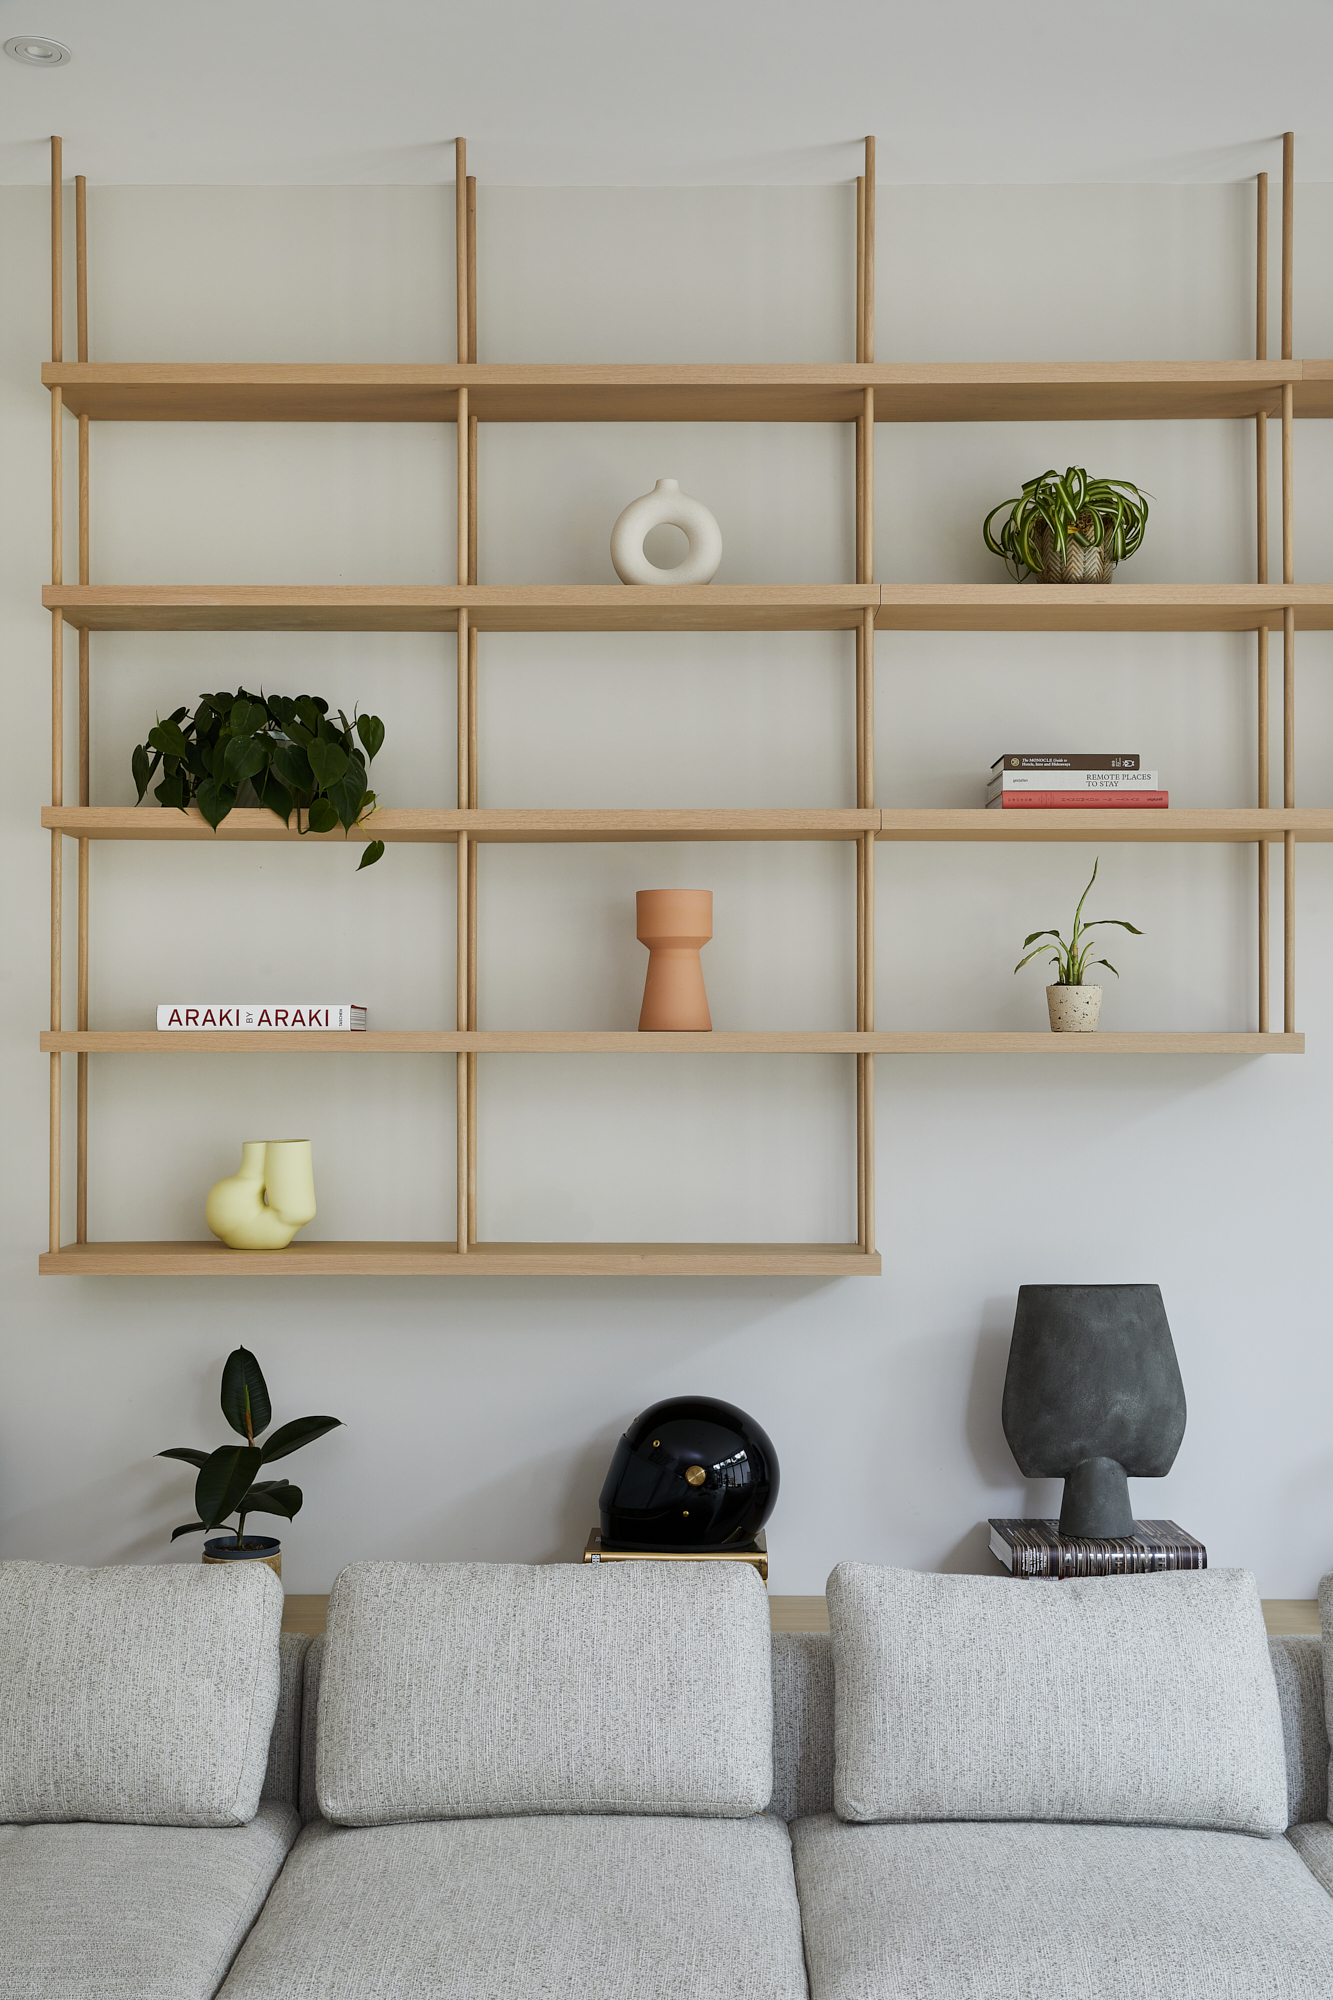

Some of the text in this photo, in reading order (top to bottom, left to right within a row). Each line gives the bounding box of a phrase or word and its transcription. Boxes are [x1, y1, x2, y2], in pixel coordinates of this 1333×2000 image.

[168, 1008, 329, 1027] ARAKI BY ARAKI
